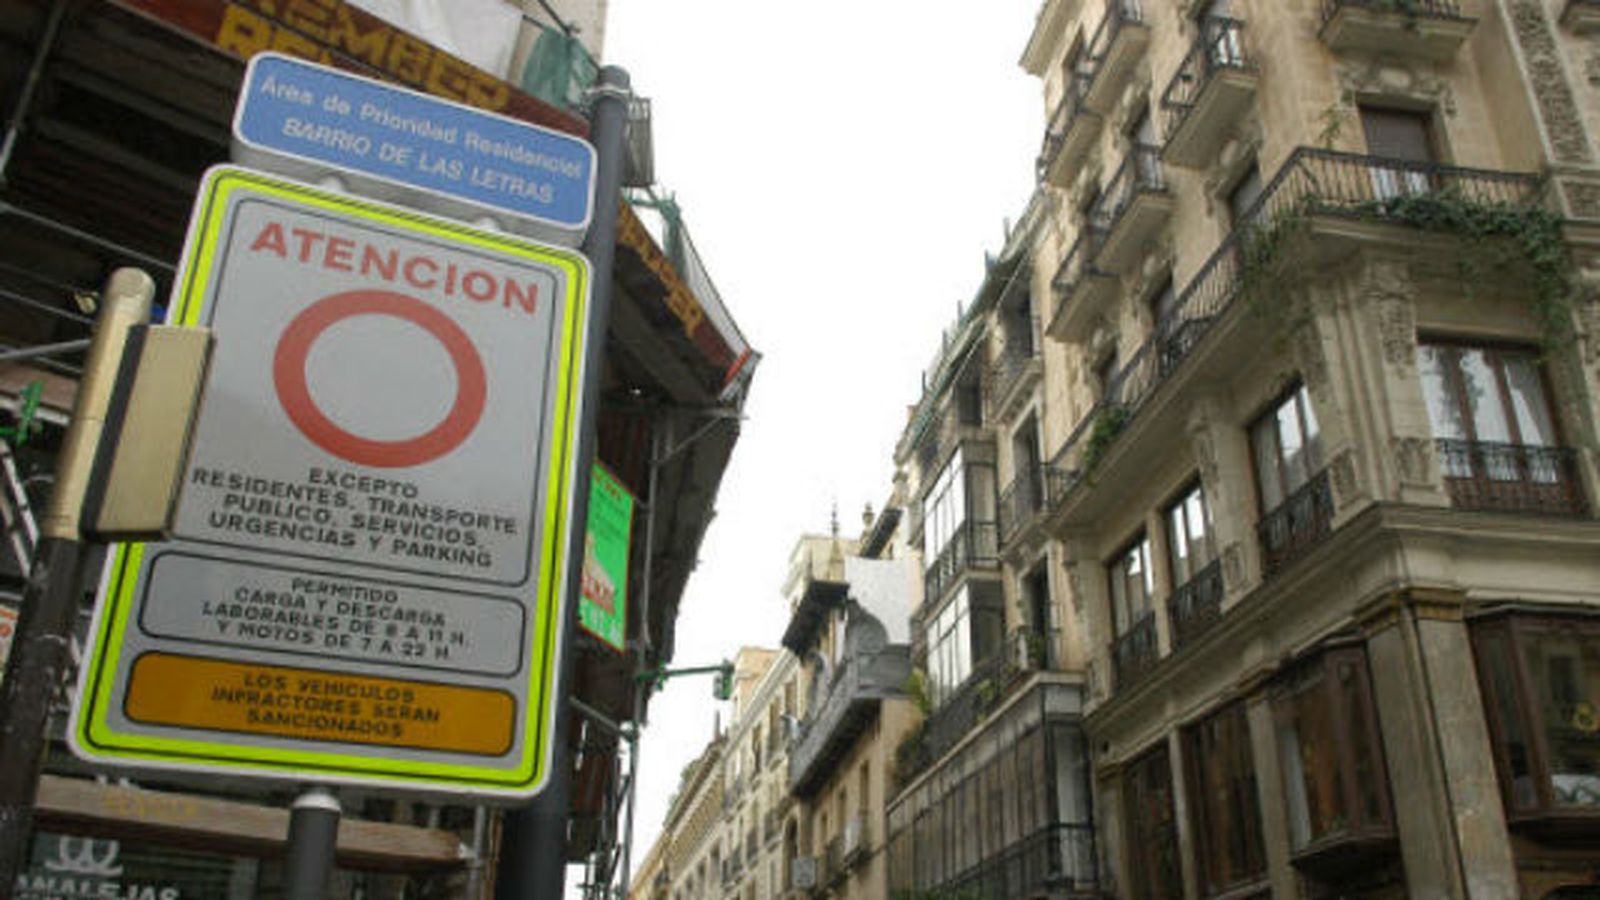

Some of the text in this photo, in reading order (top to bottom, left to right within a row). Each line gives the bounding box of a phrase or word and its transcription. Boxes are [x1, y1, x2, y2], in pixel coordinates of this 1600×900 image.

[323, 93, 351, 116] de
[360, 103, 458, 143] Prioridad
[464, 133, 582, 179] Residencial
[282, 117, 554, 204] BARRIO DE LAS LETRAS
[251, 221, 539, 315] ATENCION
[308, 467, 419, 499] EXCEPTO
[369, 497, 517, 535] TRANSPORTE
[208, 511, 494, 569] URGENCIAS Y PARKING
[234, 586, 446, 628] CARGA Y DESCARGA
[291, 577, 399, 603] PERMITIDO
[202, 601, 339, 631] LABORABLES
[350, 621, 376, 636] DE
[404, 627, 420, 641] A
[215, 620, 229, 635] Y
[238, 622, 315, 645] MOTOS
[324, 633, 351, 649] DE
[362, 637, 372, 651] 7
[380, 639, 394, 654] A
[210, 685, 441, 723] INFRACTORES SERAN
[243, 672, 416, 704] LOS VEHICULOS
[246, 709, 405, 739] SANCIONADOS
